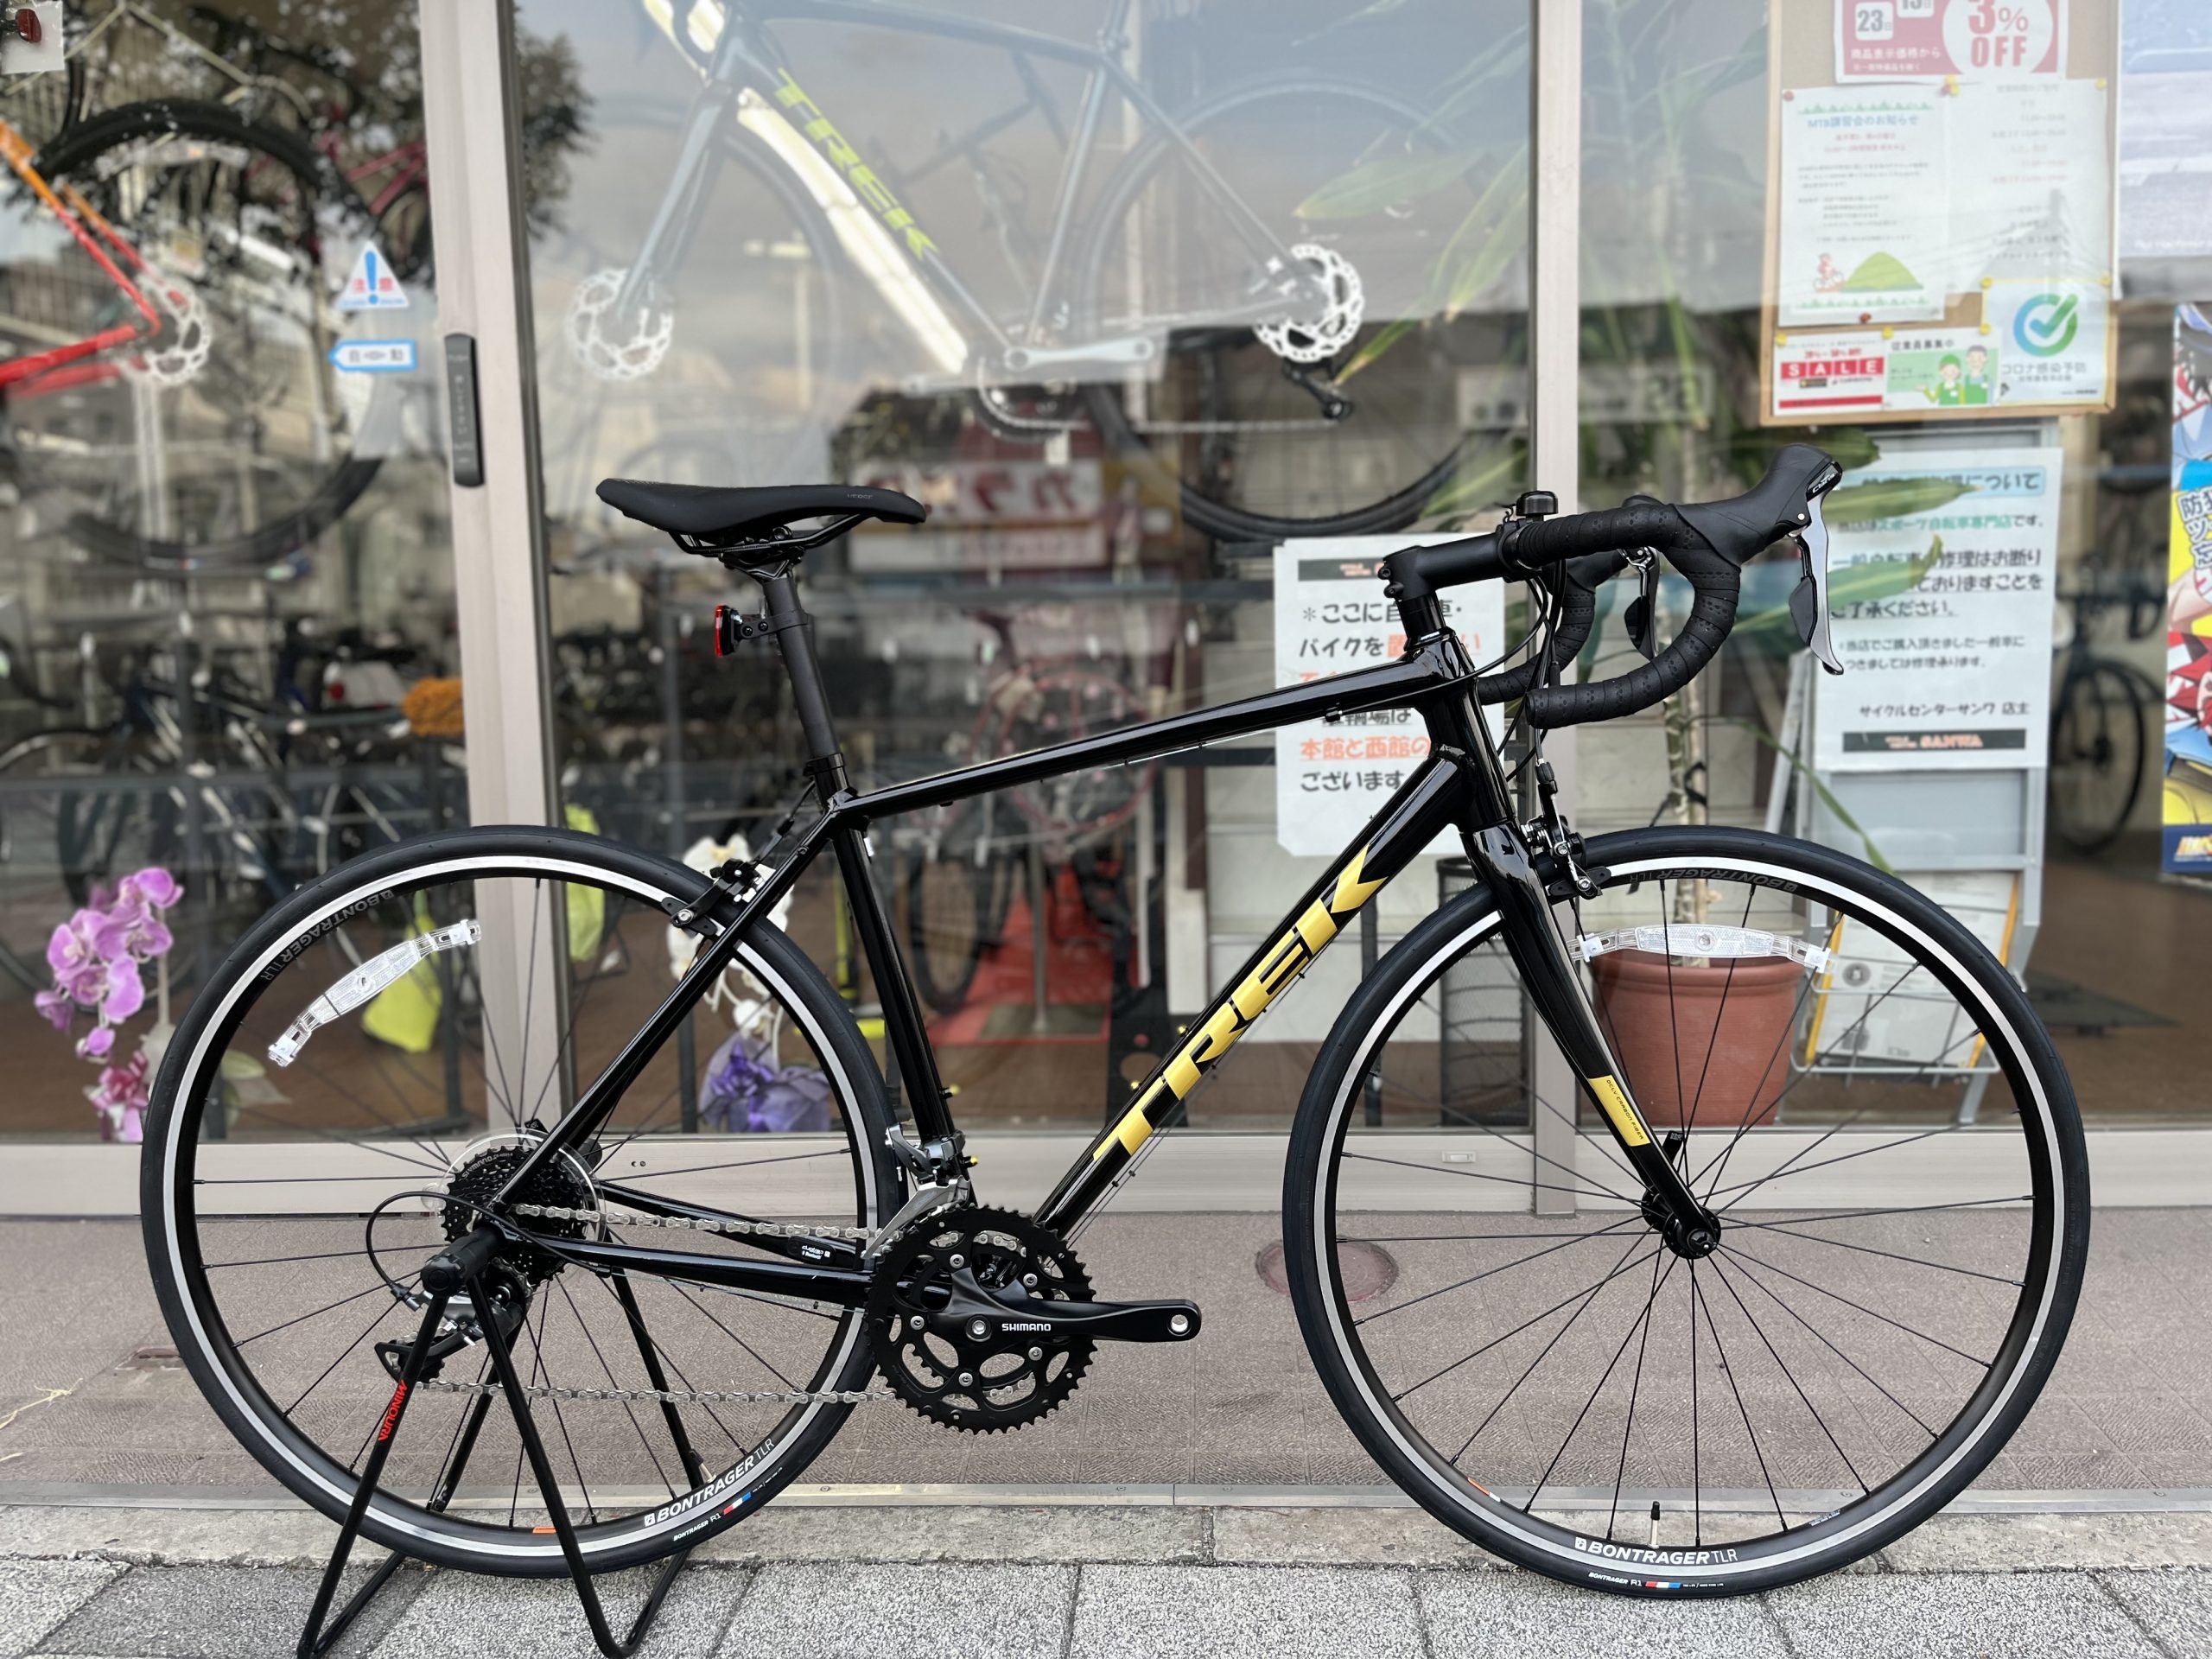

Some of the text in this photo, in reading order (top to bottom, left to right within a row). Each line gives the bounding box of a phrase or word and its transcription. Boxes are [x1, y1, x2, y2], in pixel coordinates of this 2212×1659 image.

[1971, 36, 2027, 67] OFF
[775, 67, 941, 261] TREK
[1788, 359, 1877, 378] SALE
[1656, 868, 1785, 887] BONTRAGER
[259, 892, 380, 982] BONTRAGER TLR
[1093, 843, 1389, 1157] TREK
[1001, 1323, 1052, 1332] SHIMANO
[378, 1378, 409, 1442] MINOURA
[657, 1455, 755, 1523] BONTRAGER
[753, 1438, 775, 1460] TLR
[673, 1513, 722, 1541] BONTRAGER R1
[1587, 1541, 1738, 1565] BONTRAGER TLR
[1588, 1572, 1629, 1585] BONTRAGER
